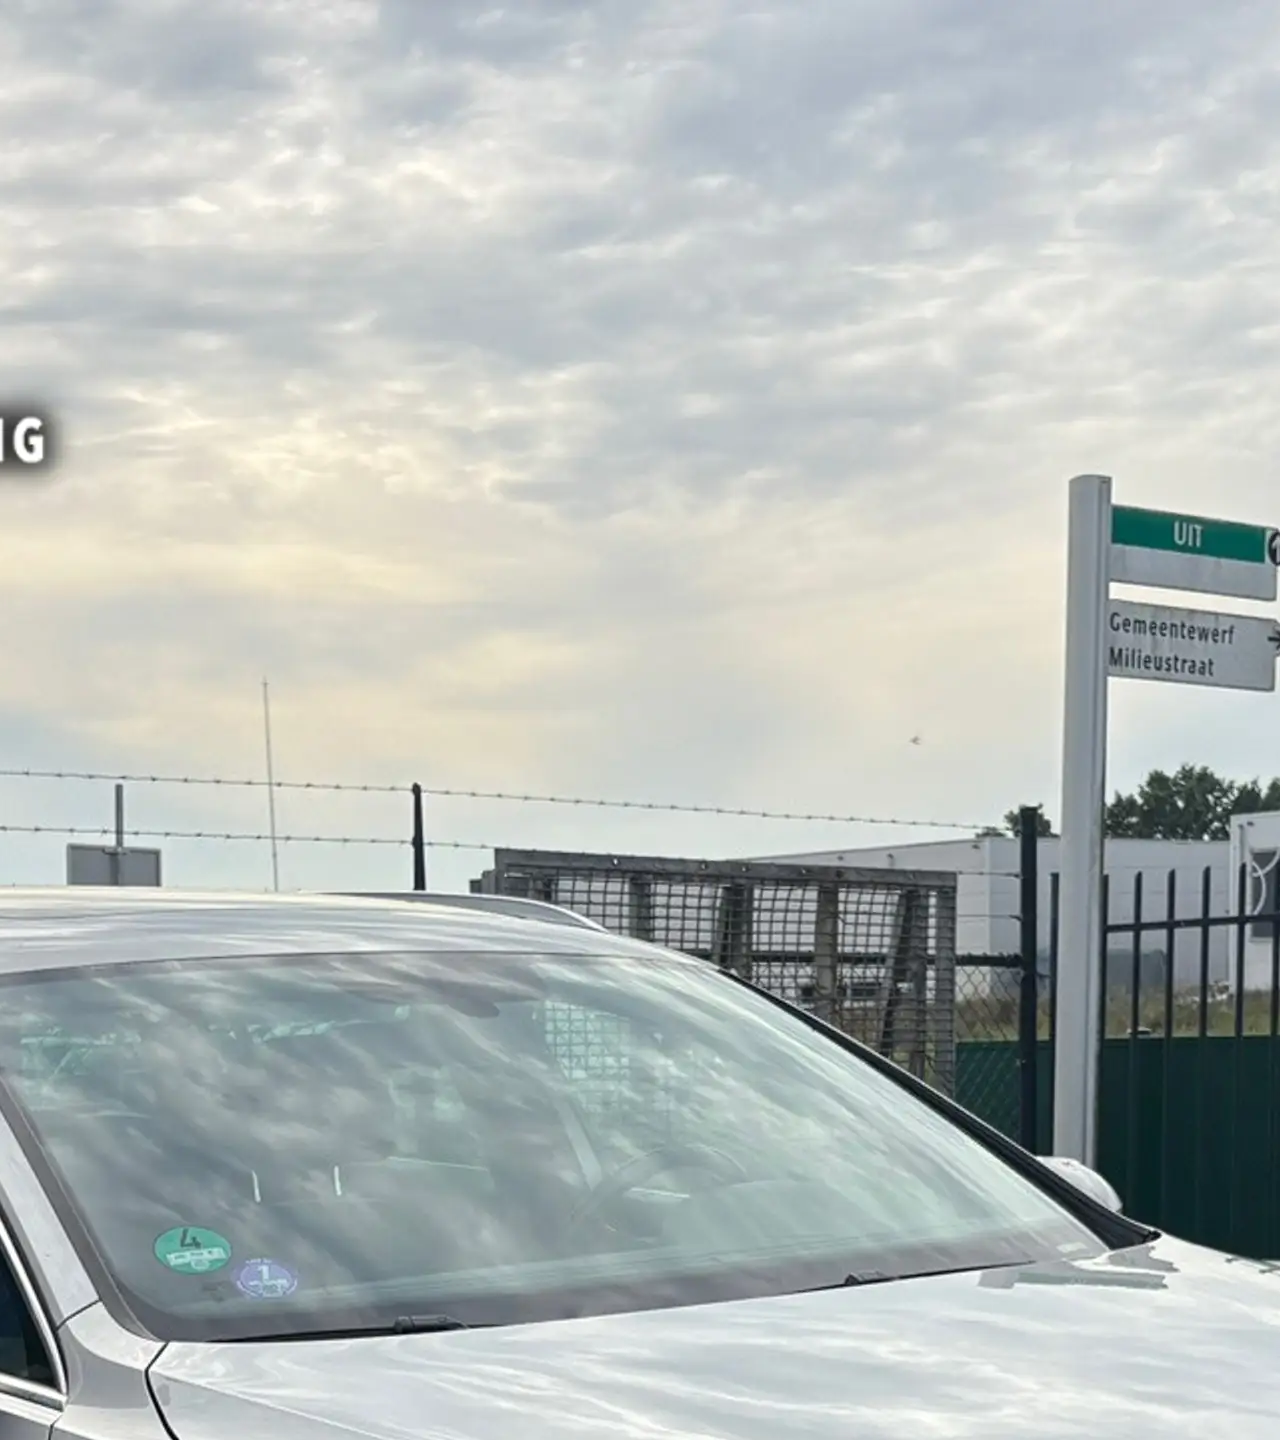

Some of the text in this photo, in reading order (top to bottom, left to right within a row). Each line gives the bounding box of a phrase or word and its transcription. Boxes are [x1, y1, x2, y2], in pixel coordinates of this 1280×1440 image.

[1173, 521, 1203, 548] UIT
[1109, 612, 1235, 645] Gemeentewerf
[1108, 646, 1215, 677] Milieustraat
